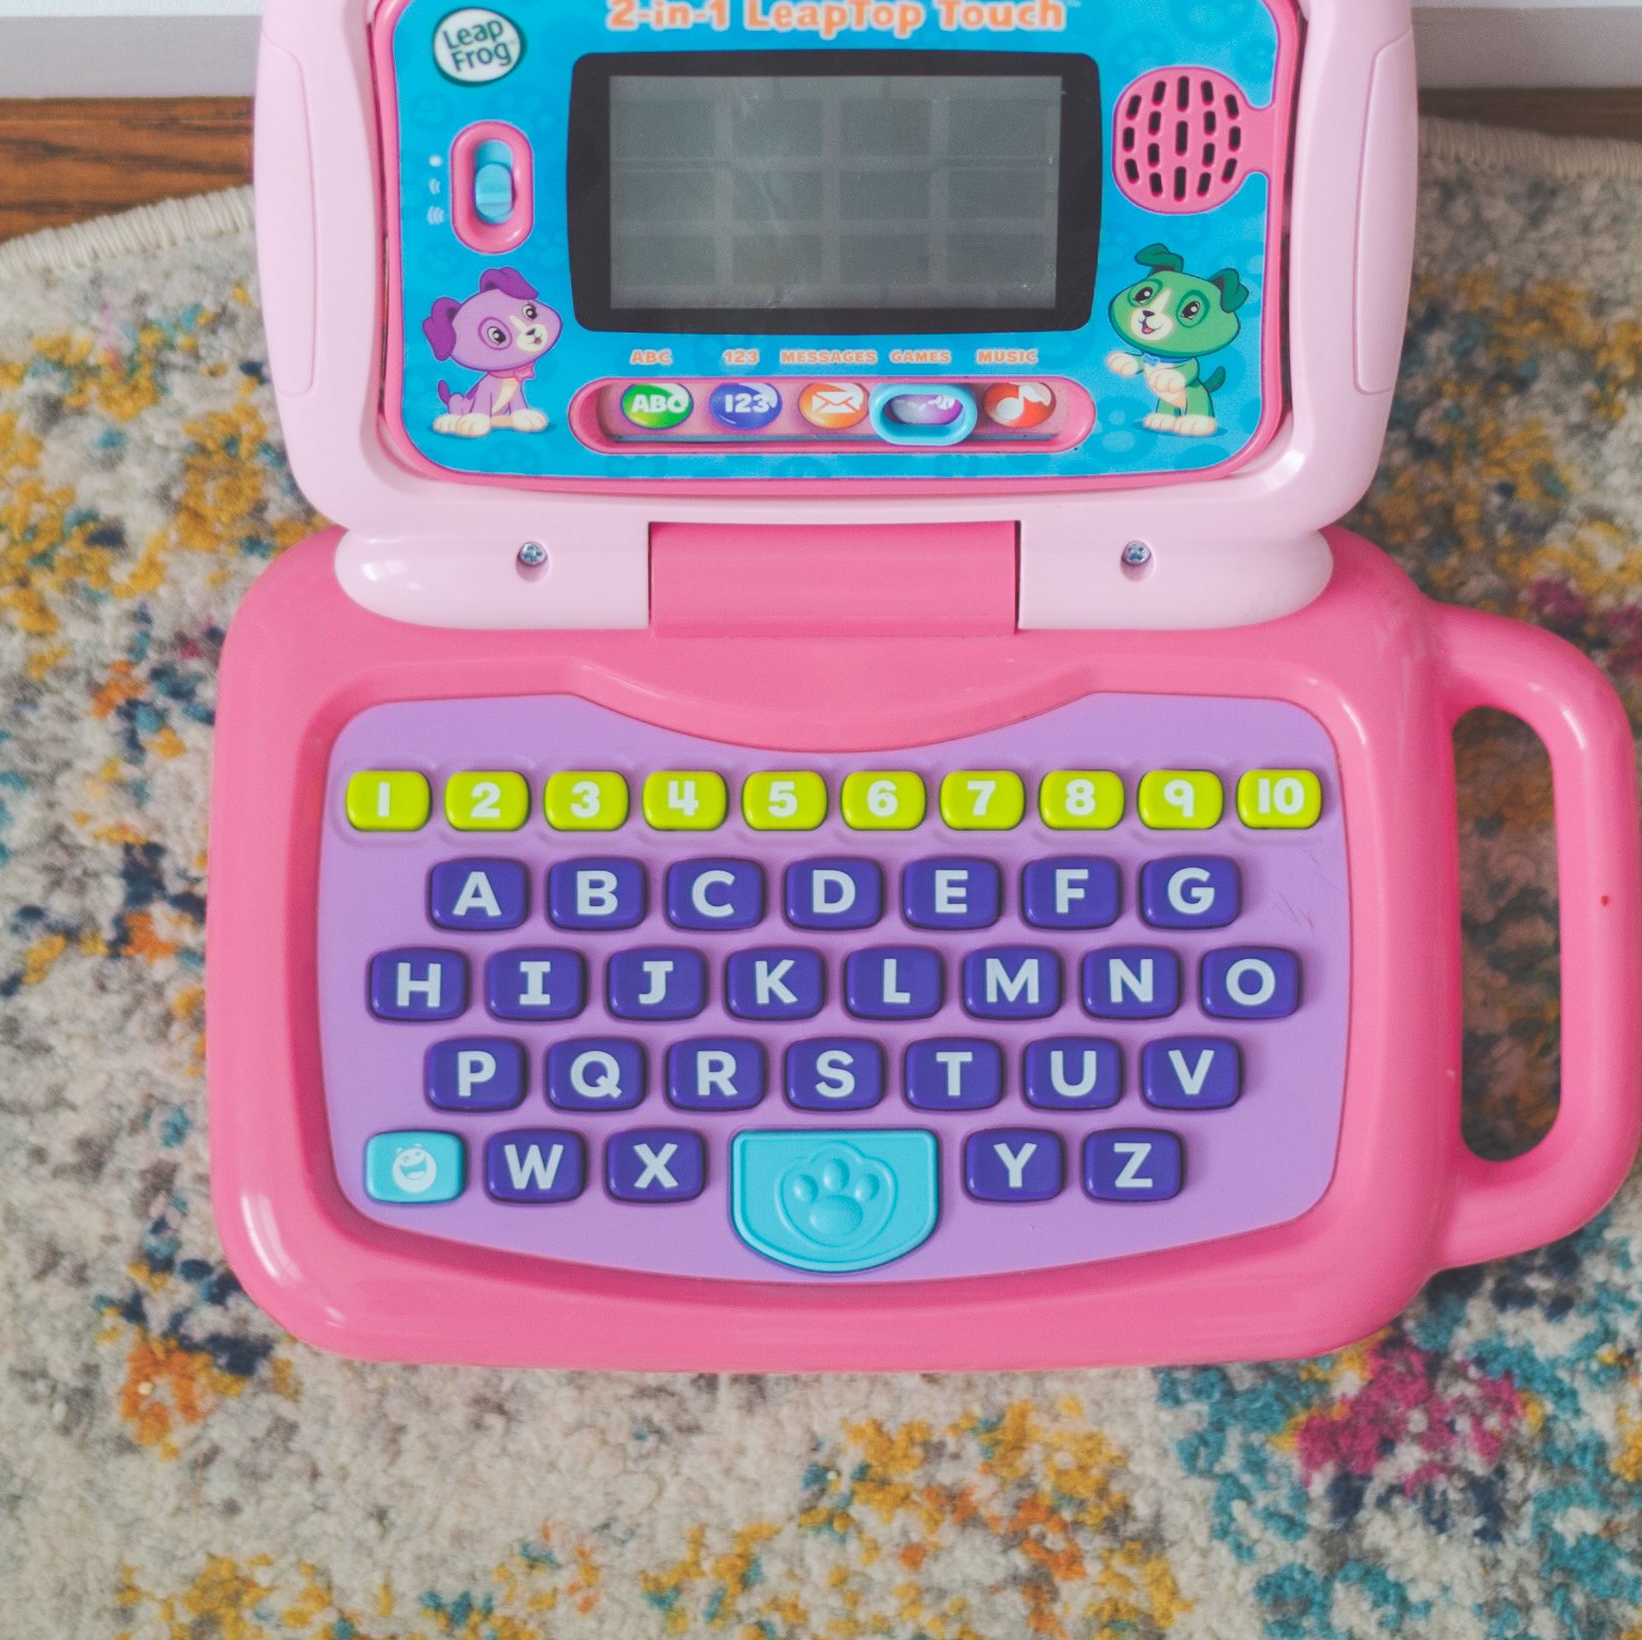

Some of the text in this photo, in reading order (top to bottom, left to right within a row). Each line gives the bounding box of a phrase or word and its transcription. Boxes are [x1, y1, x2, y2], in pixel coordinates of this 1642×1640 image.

[443, 17, 504, 50] Leap
[450, 41, 513, 73] Frog
[630, 348, 1039, 366] ABC 123 MESSAGES GAMES MUSIC
[632, 393, 769, 414] ABC 123
[377, 777, 1305, 819] 1 2 3 4 5 6 7 8 9 10
[452, 867, 1216, 919] A B C D E F G
[396, 958, 1276, 1009] H I J K L M N O
[457, 1049, 1215, 1099] P Q R S T U V
[503, 1142, 1154, 1191] W X Y Z
